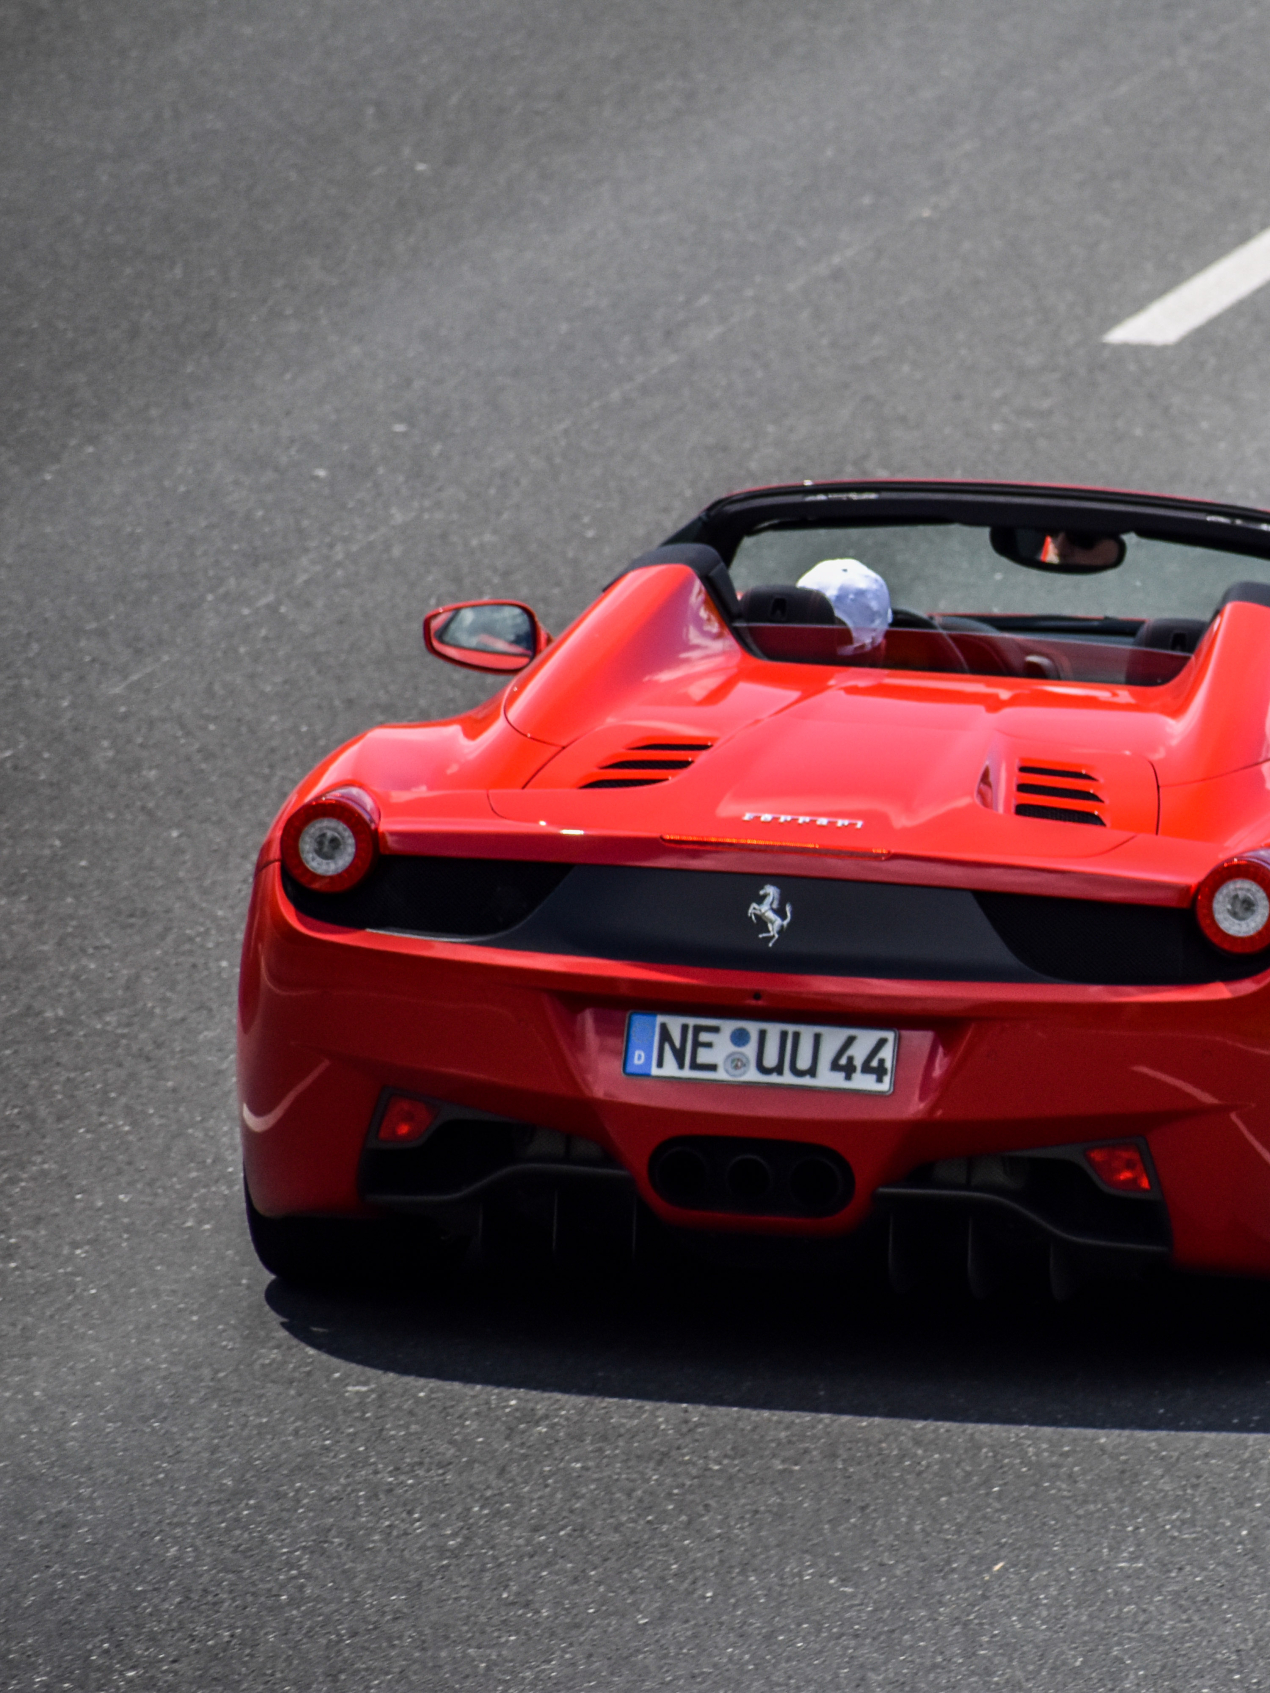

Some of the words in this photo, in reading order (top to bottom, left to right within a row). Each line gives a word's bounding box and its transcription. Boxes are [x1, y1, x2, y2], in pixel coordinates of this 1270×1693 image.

[743, 813, 863, 828] Ferrari
[633, 1050, 645, 1065] D
[656, 1022, 720, 1072] NE
[755, 1028, 822, 1079] UU
[830, 1035, 889, 1084] 44
